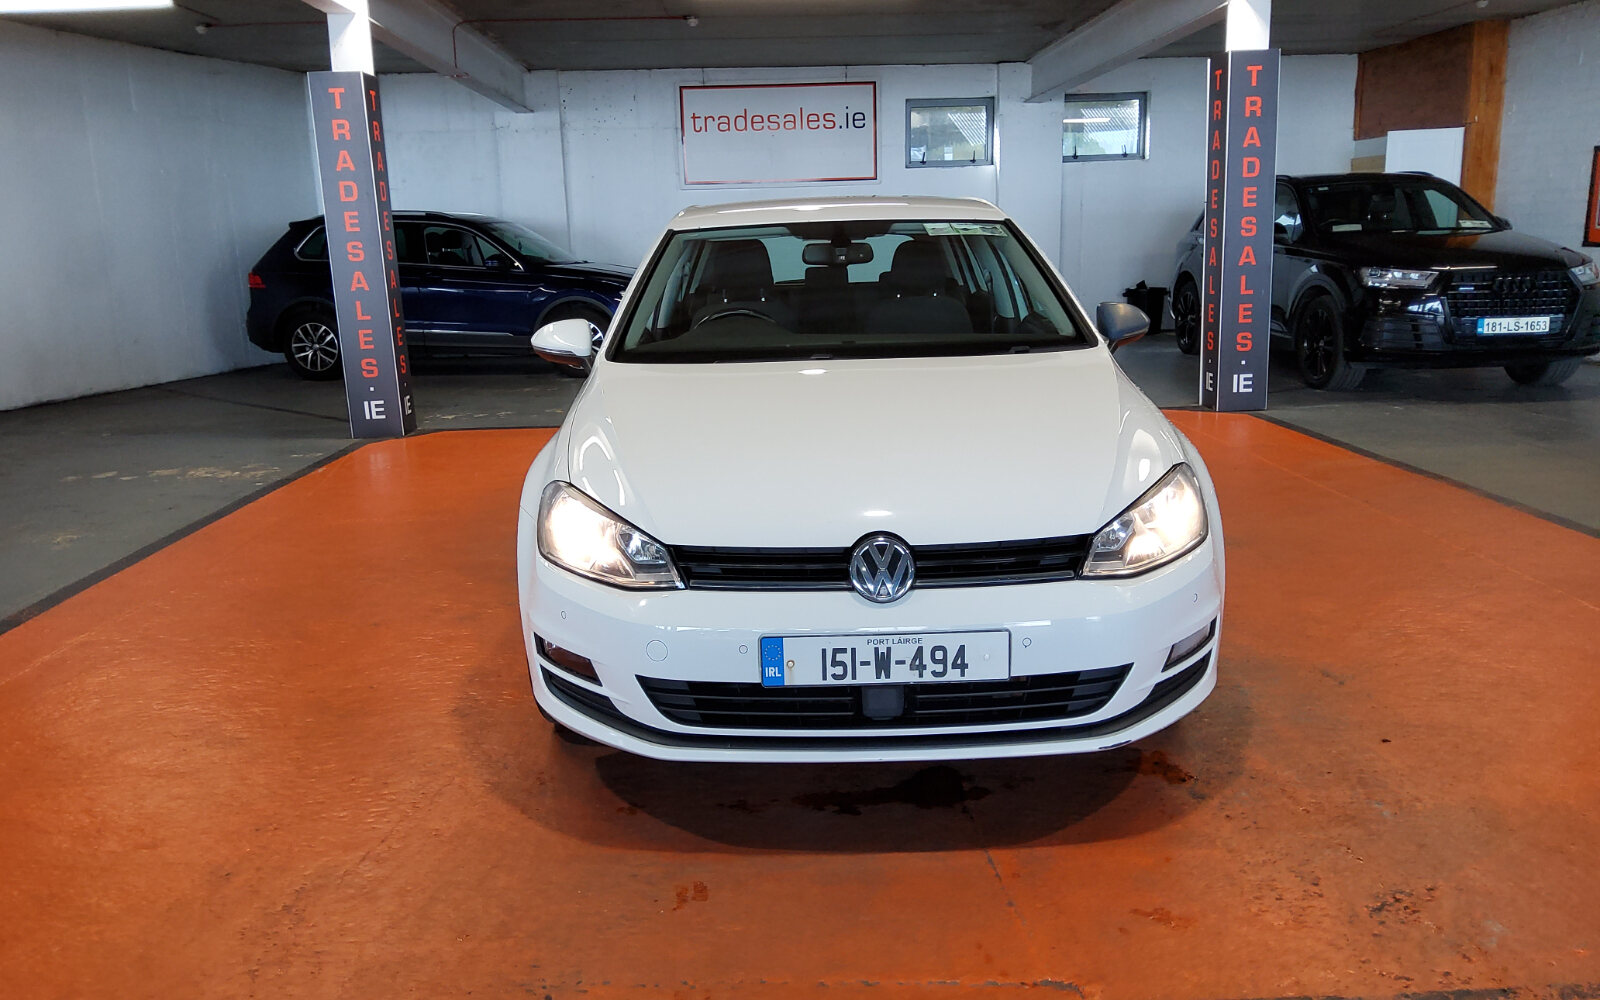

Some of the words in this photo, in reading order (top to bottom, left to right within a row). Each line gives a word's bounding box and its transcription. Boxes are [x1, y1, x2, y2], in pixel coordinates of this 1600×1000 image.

[690, 105, 866, 133] tradesales.ie
[1485, 320, 1548, 332] 181-LS-1653
[765, 666, 782, 678] IRL
[821, 644, 969, 681] 151-W-494
